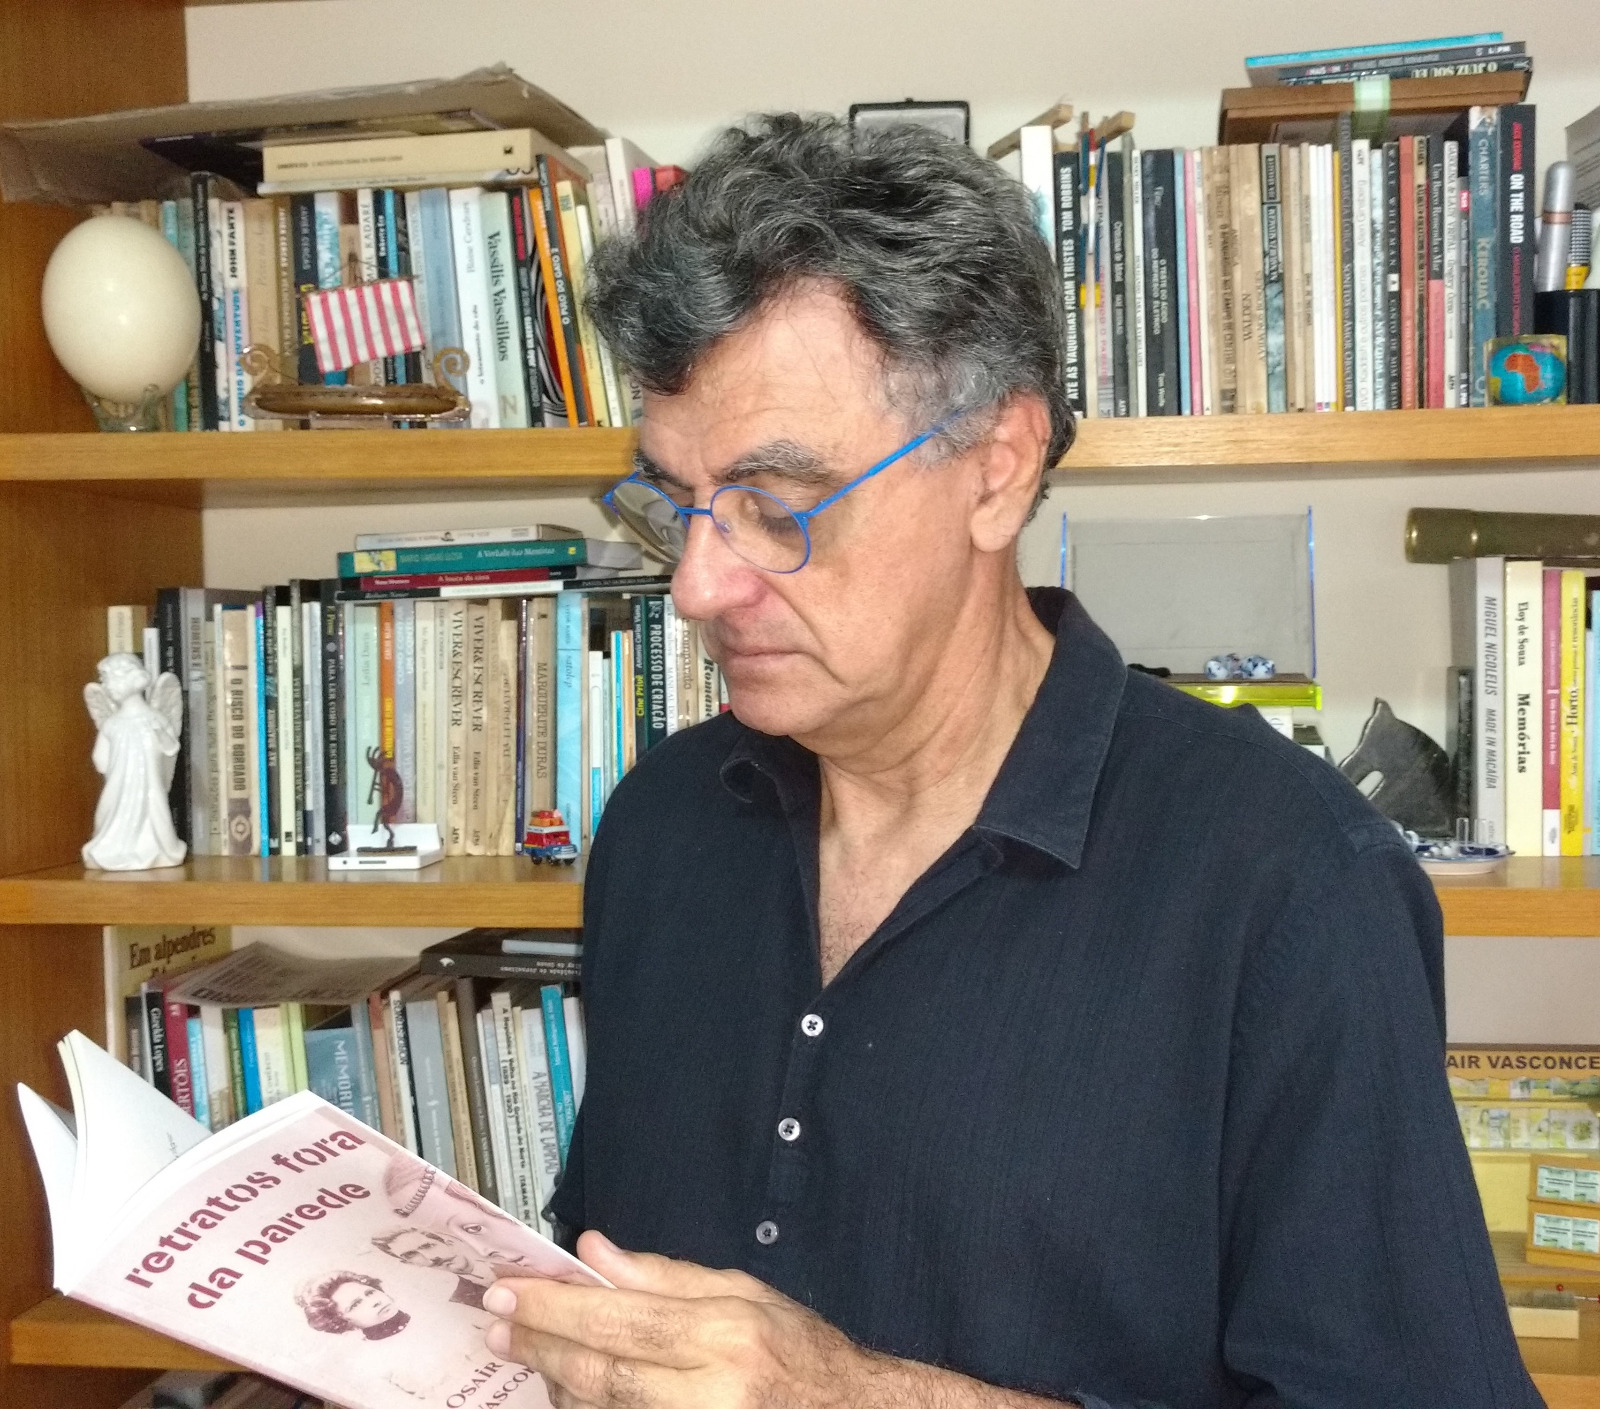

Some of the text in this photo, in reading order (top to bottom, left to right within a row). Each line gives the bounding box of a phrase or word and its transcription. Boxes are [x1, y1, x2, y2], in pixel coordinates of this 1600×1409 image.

[1510, 173, 1524, 191] ON
[1432, 163, 1443, 272] Um Barco Remenda Mar
[1510, 193, 1524, 212] THE
[278, 206, 287, 233] JAVIER
[1476, 138, 1491, 310] CHARTERS KEROUAC
[1510, 214, 1525, 244] ROAD
[226, 206, 239, 279] JOHN FANTE
[279, 234, 288, 268] CERCAS
[299, 205, 311, 270] JAVIER CERCAS
[1151, 259, 1161, 298] REFRESCO
[1159, 265, 1168, 288] TESTE
[1387, 149, 1398, 377] WALT WHITMAN CANTO DE MIM
[487, 231, 511, 362] Vassilis Vassilikos
[551, 256, 570, 318] PULO DO GATO
[1060, 166, 1079, 400] ATÉ AS VAQUEIRAS FICAM TRISTES TOM ROBBINS
[1160, 290, 1168, 300] DO
[1355, 179, 1370, 383] Kaddish outros poemas Allen Ginsberg
[233, 289, 244, 356] JUVENTUDE
[1241, 293, 1254, 341] WALDEN
[1344, 320, 1354, 349] AMOR
[1157, 373, 1167, 387] Tom
[1344, 351, 1355, 398] OBSCURO
[500, 395, 518, 419] Z
[634, 604, 643, 622] Viana
[190, 617, 201, 661] HOMENS
[634, 623, 643, 644] Carlos
[361, 632, 373, 687] Lydia Davis
[230, 677, 243, 685] O
[634, 674, 645, 696] Privê
[650, 624, 667, 729] PROCESSO DE CRIAÇÃO
[667, 667, 675, 703] MANUAL
[1484, 596, 1498, 789] MIGUEL NICOLELIS MADE IN MACAÍBA
[1515, 601, 1531, 774] Eloy de Souza Memórias
[231, 690, 244, 721] RISCO
[327, 658, 338, 785] PARA LER COMO UM ESCRITOR
[536, 662, 548, 779] MARGUERITE DURAS
[635, 697, 645, 717] Cine
[1565, 687, 1580, 726] Horto,
[231, 725, 245, 739] DO
[294, 702, 302, 751] ESCREVER
[453, 766, 461, 781] van
[473, 771, 481, 787] van
[452, 782, 461, 805] Steen
[472, 787, 482, 811] Steen
[129, 926, 217, 970] Em alpendres
[152, 1043, 165, 1073] Lopes
[508, 1058, 517, 1078] Velha
[1447, 1054, 1600, 1070] AIR VASCONCE
[173, 1058, 191, 1117] ERTÕES
[532, 1071, 546, 1080] A
[512, 1091, 520, 1104] Rio
[533, 1080, 551, 1118] MARCHA
[514, 1106, 523, 1133] Grande
[540, 1120, 554, 1133] DE
[519, 1175, 528, 1206] ITAMAR
[124, 1129, 367, 1289] retratos fora
[523, 1209, 530, 1220] DE
[187, 1182, 371, 1310] da parede
